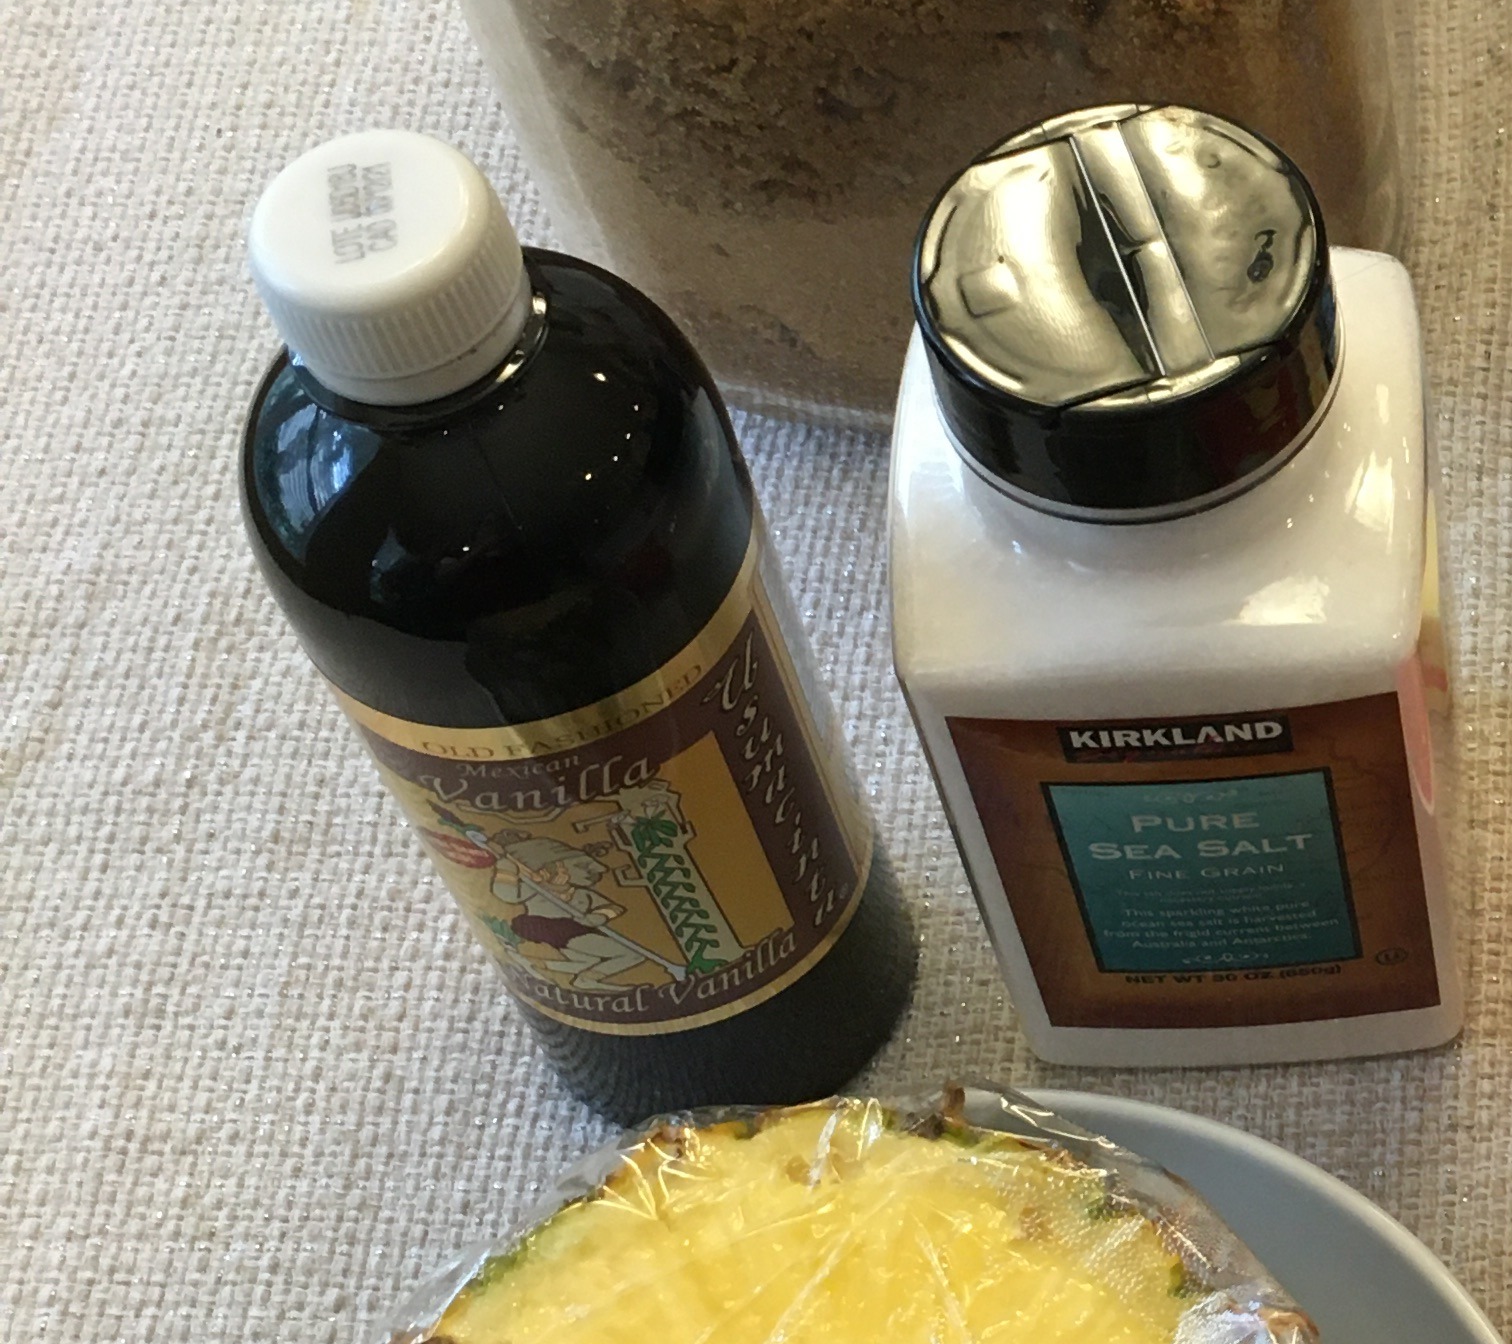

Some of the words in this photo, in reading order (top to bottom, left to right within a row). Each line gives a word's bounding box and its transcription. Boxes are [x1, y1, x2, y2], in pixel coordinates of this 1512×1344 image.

[422, 740, 495, 759] OLD
[506, 664, 703, 757] FASHIONED
[1068, 720, 1284, 750] KIRKLAND
[456, 754, 581, 781] Mexican
[418, 755, 656, 811] Vanilla
[1130, 812, 1261, 834] PURE
[1088, 841, 1183, 861] SEA
[1196, 833, 1313, 858] SALT
[1128, 869, 1188, 881] FINE
[1200, 863, 1284, 879] GRAIN
[1121, 919, 1166, 929] ocean
[1170, 919, 1196, 928] sea
[1199, 917, 1224, 927] salt
[1244, 909, 1318, 924] harvested
[1125, 908, 1153, 918] This
[1159, 908, 1226, 919] sparkling
[1230, 904, 1272, 914] white
[1275, 900, 1311, 911] pure
[1103, 928, 1141, 939] from
[1145, 928, 1169, 939] the
[1173, 927, 1211, 939] frigid
[1215, 924, 1270, 937] current
[1275, 916, 1340, 933] between
[1131, 939, 1196, 950] Australia
[1201, 937, 1229, 948] and
[508, 964, 650, 1014] Natural
[658, 932, 797, 1006] Vanilla
[1124, 973, 1168, 985] NET
[1173, 972, 1204, 985] WT
[1243, 970, 1276, 982] OZ
